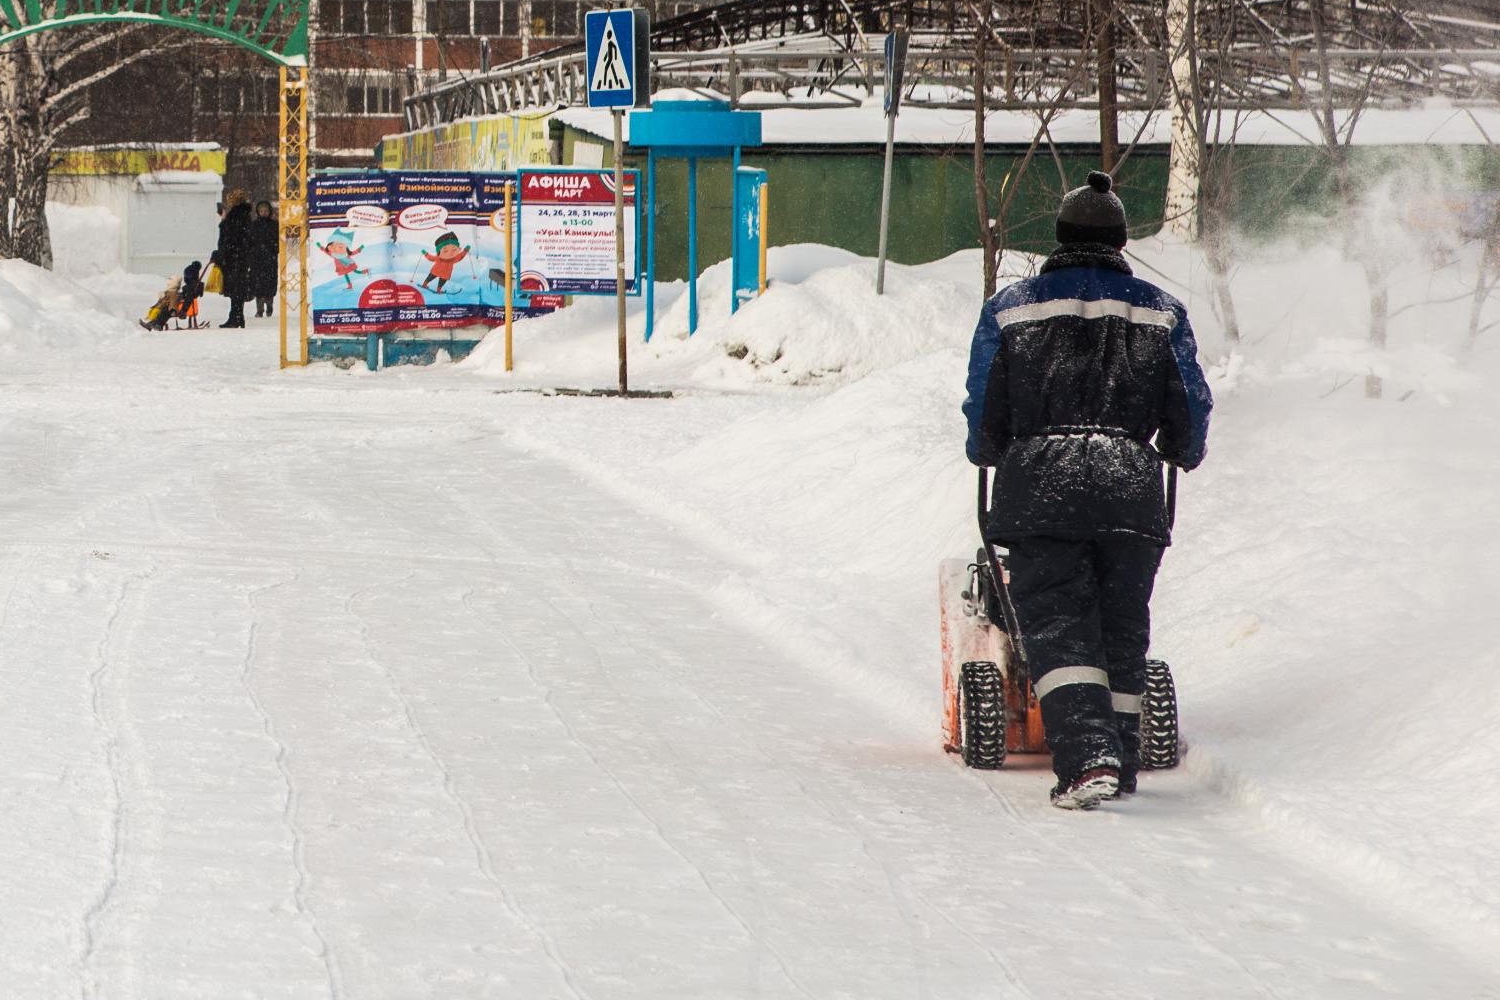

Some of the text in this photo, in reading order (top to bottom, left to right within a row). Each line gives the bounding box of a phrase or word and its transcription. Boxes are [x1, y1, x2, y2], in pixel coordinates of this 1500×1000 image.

[528, 175, 592, 189] АФИША
[315, 186, 388, 196] #зимойможно
[399, 183, 472, 193] #зимойможно
[554, 188, 584, 198] МАРТ
[404, 212, 424, 220] Взять
[538, 209, 551, 217] 24,
[552, 209, 566, 217] 26,
[567, 209, 580, 217] 28,
[582, 209, 591, 217] 31
[535, 228, 615, 238] «Ура! Каникулы!
